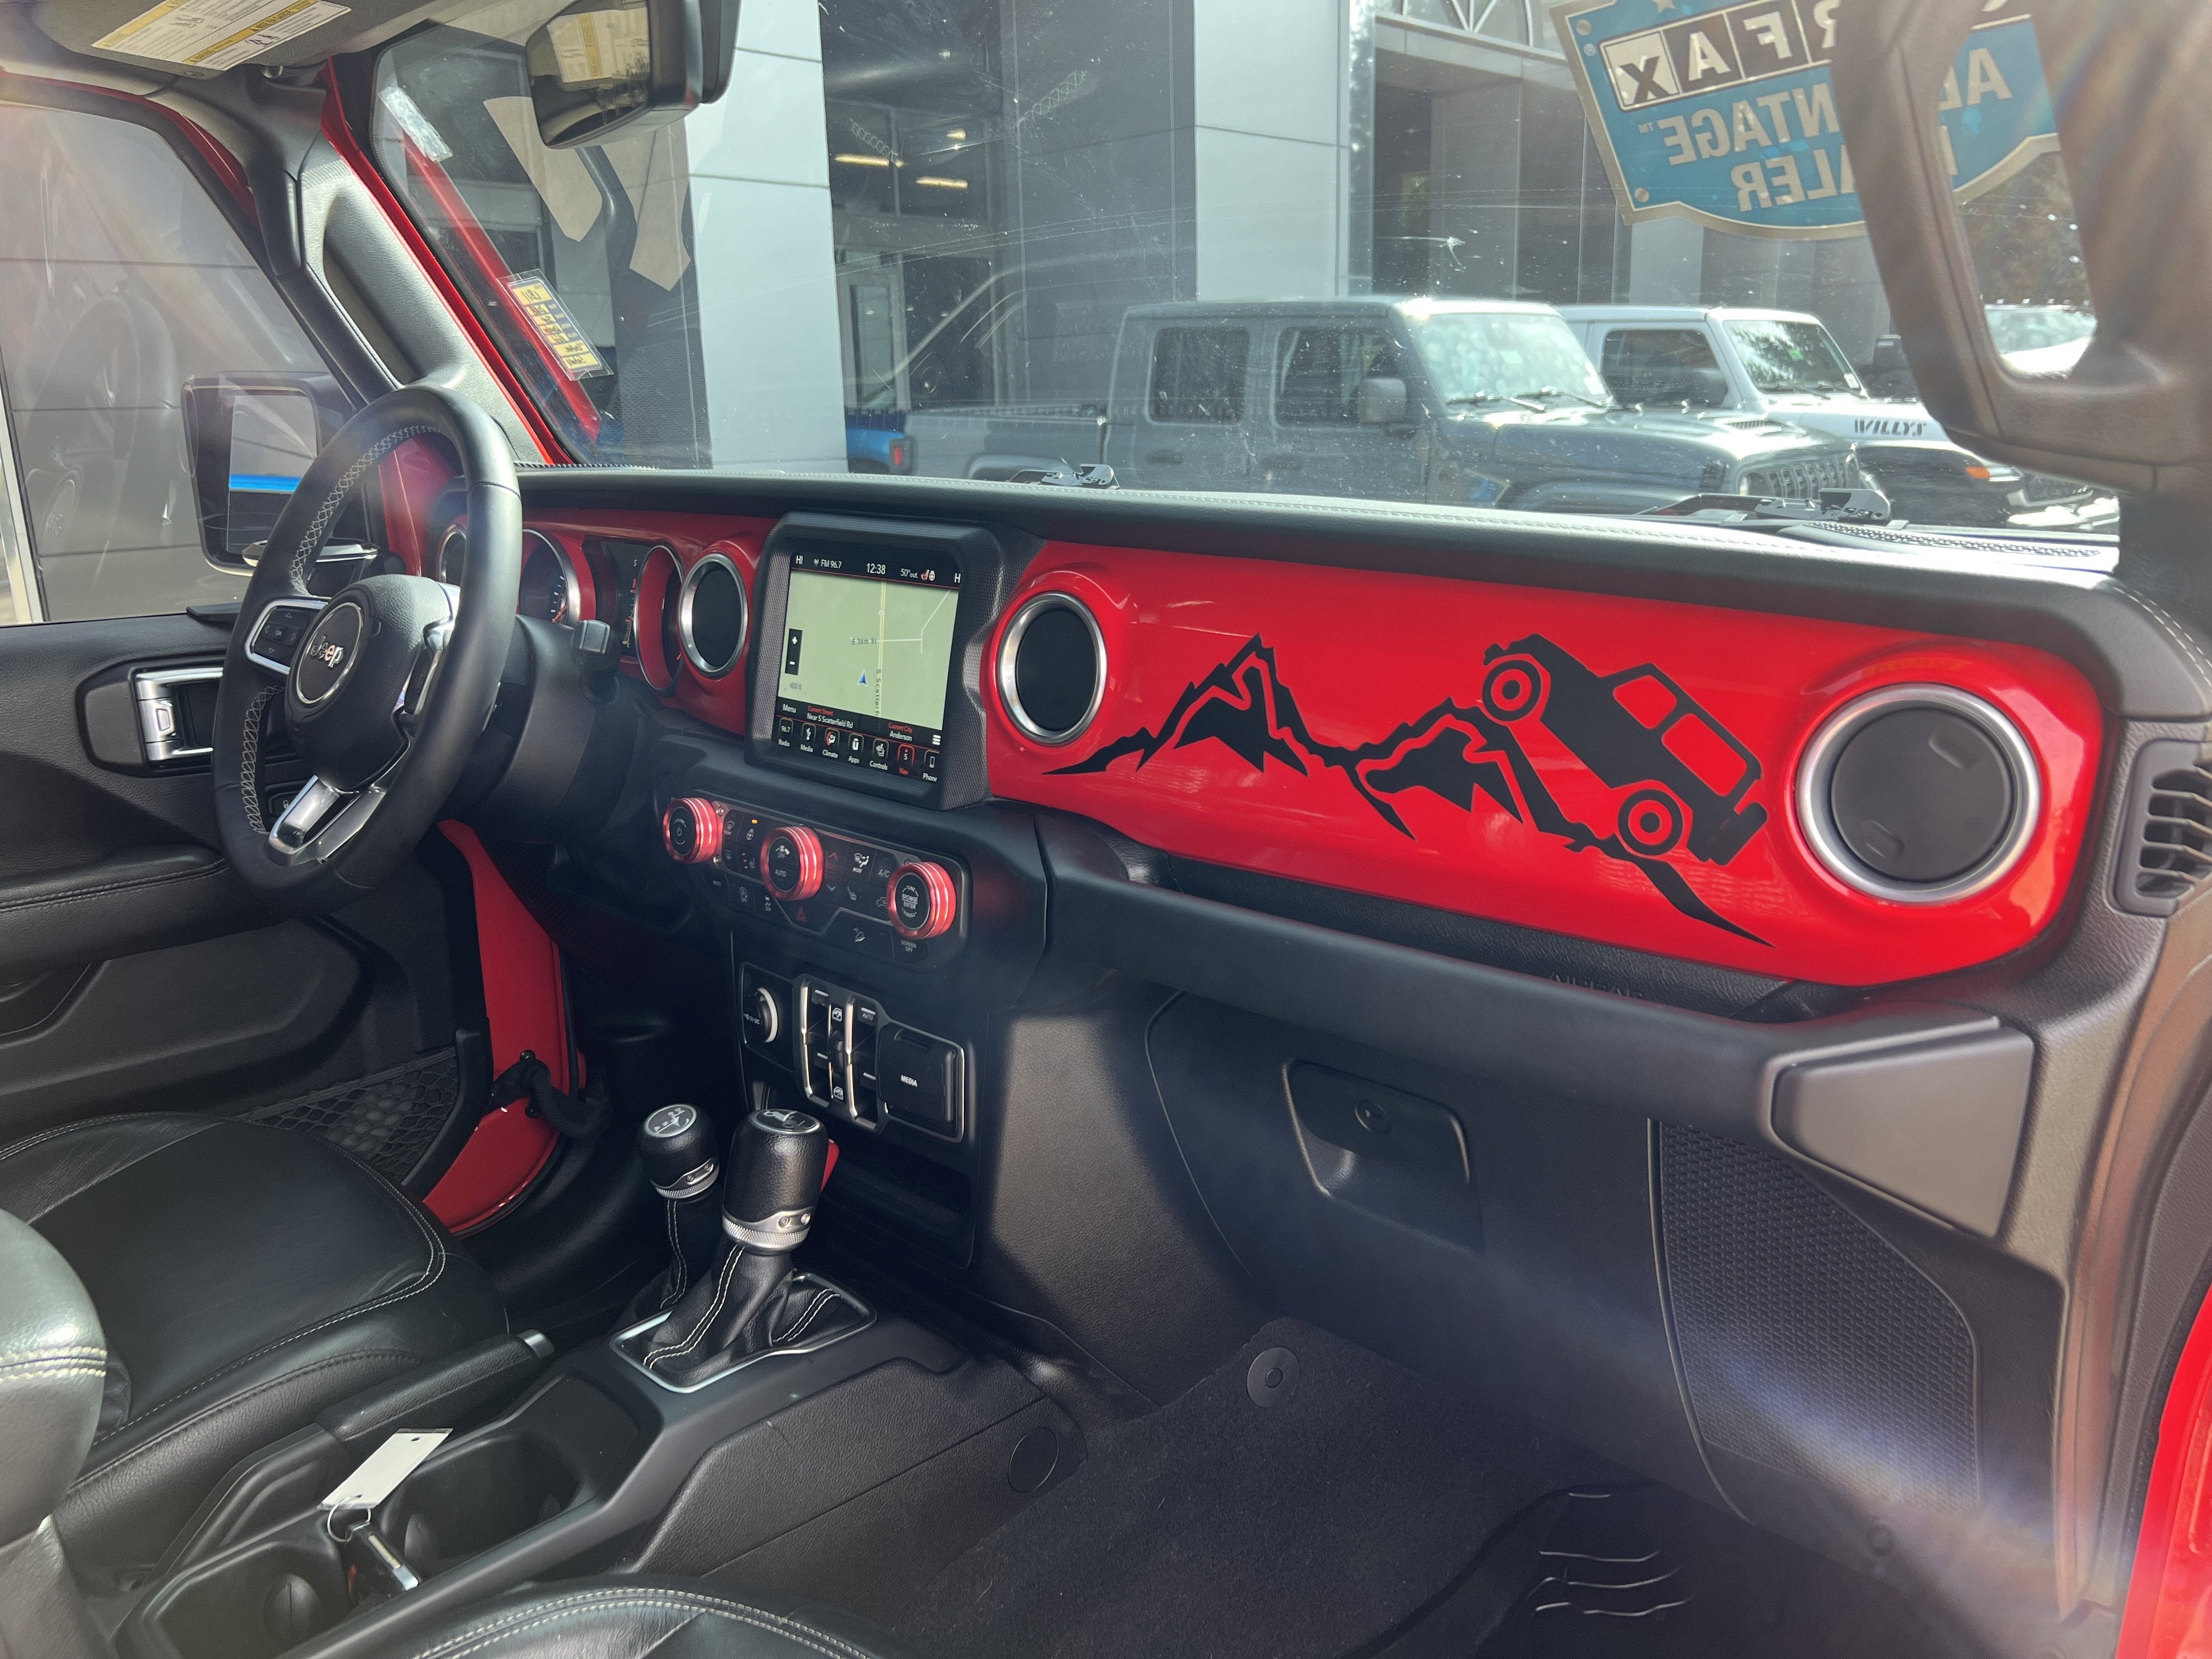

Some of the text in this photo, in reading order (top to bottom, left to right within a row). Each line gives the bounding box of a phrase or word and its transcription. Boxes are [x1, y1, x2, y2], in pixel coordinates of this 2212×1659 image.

[795, 555, 803, 565] HI
[821, 559, 842, 569] FM 96.7
[866, 563, 886, 574] 12:38
[954, 573, 961, 583] H
[310, 635, 344, 668] Jeep
[783, 703, 797, 713] Menu
[807, 713, 817, 721] Near
[889, 730, 912, 742] Anderson
[923, 772, 938, 782] Phone
[878, 868, 890, 878] A/C
[902, 893, 918, 902] BROWSE
[904, 901, 916, 910] ENTER
[901, 939, 917, 949] SCREEN
[862, 1013, 873, 1021] AUTO
[901, 1074, 918, 1088] MEDIA
